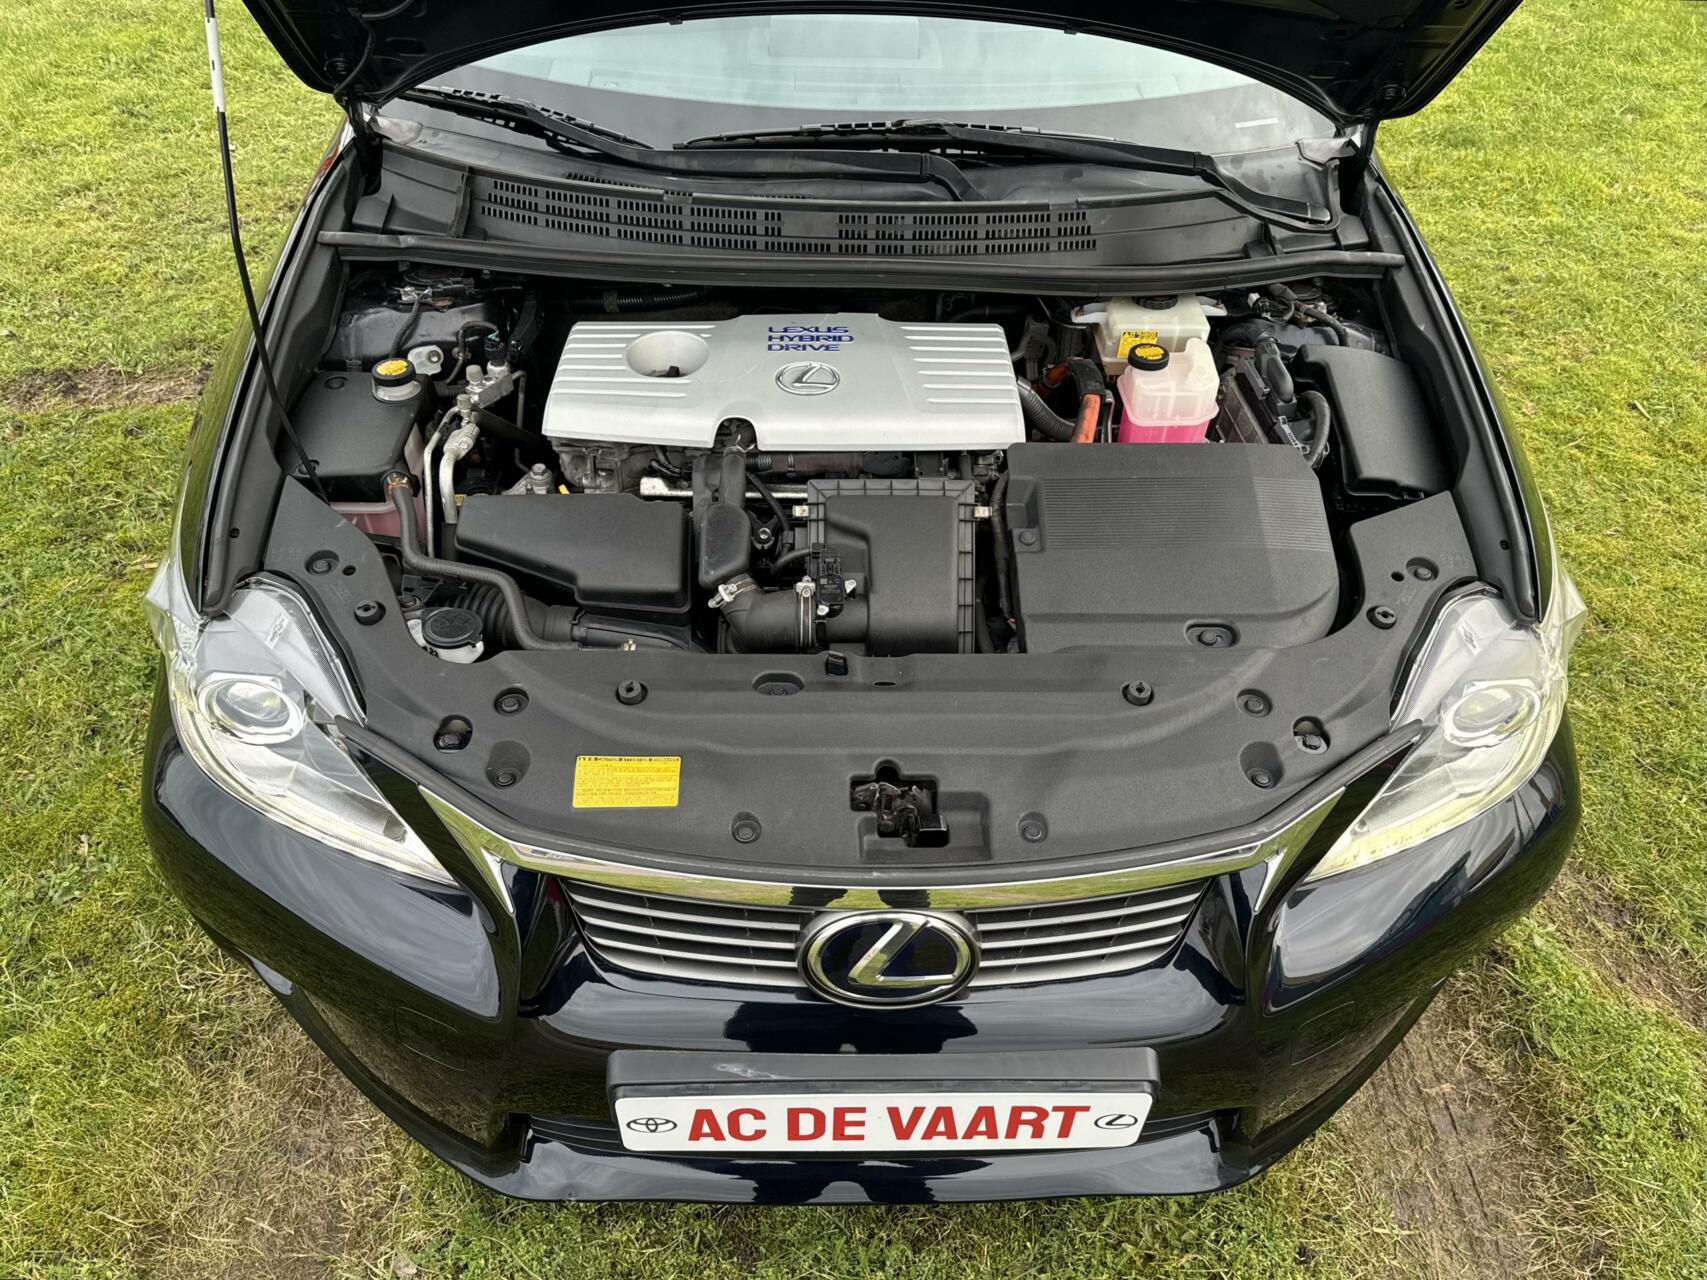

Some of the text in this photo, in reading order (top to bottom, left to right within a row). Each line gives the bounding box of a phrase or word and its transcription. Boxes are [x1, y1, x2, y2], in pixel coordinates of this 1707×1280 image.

[768, 326, 849, 334] LEXUS
[767, 344, 841, 352] DRIVE
[687, 1105, 1091, 1142] AC DE VAART
